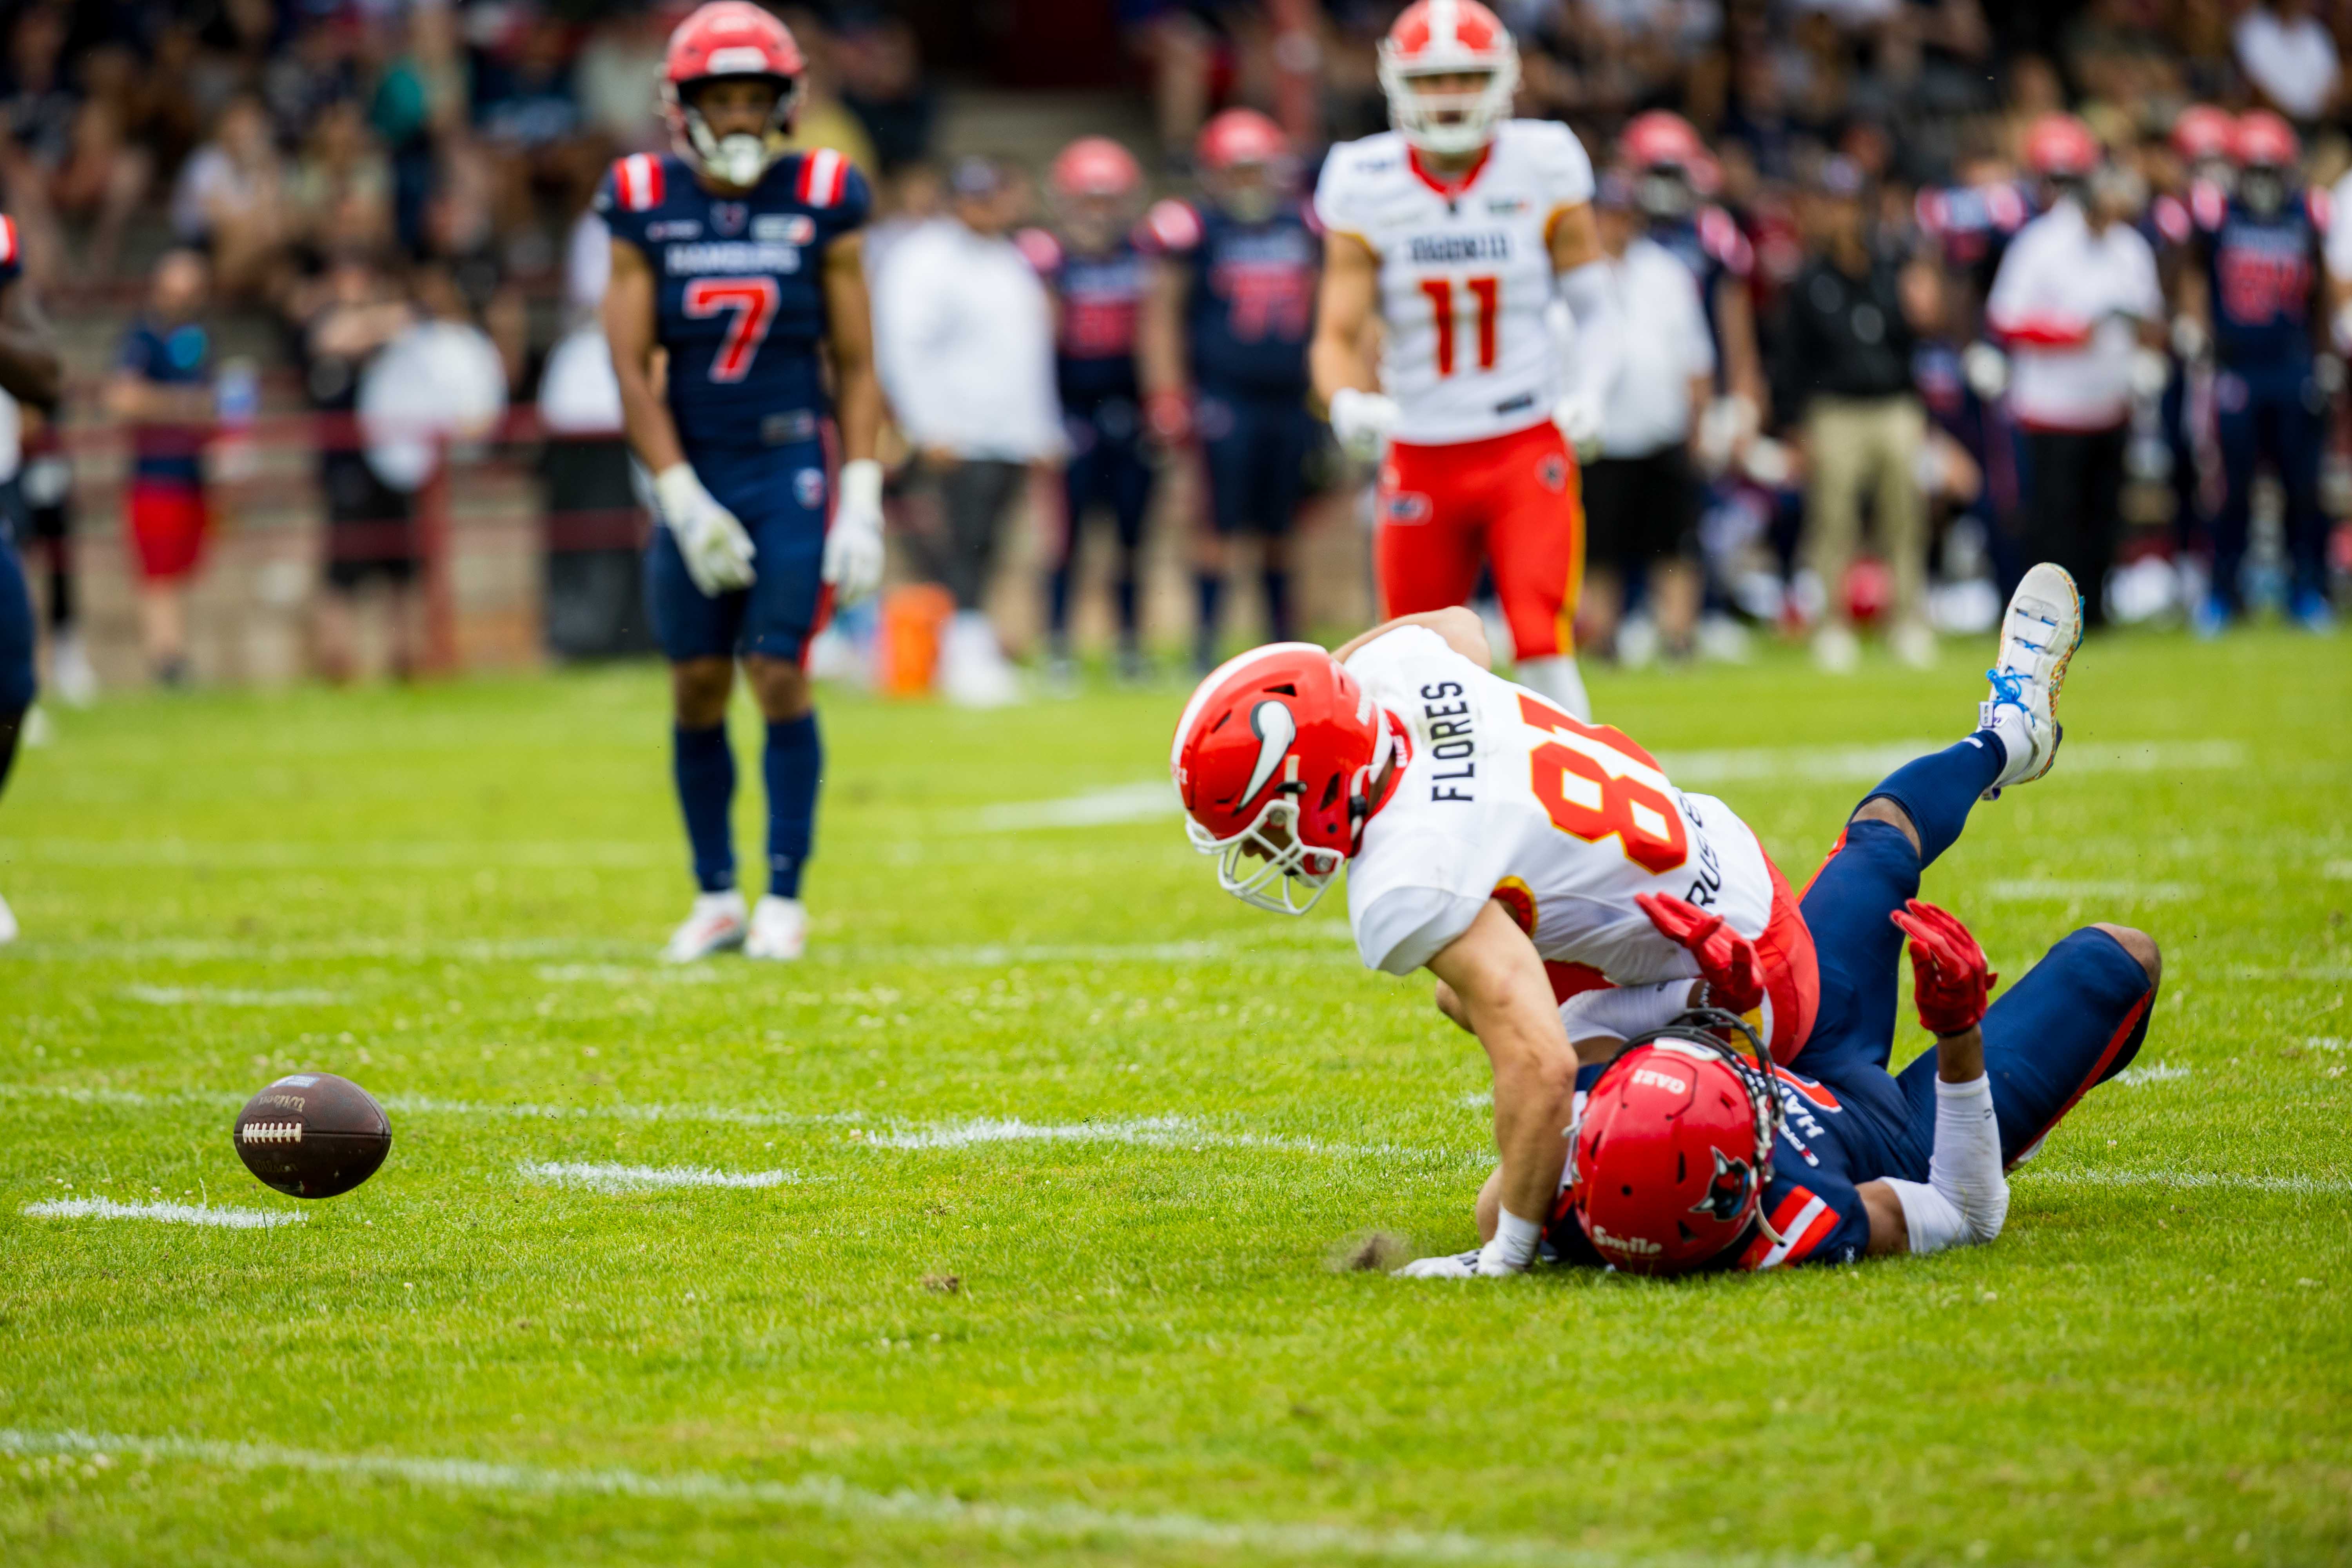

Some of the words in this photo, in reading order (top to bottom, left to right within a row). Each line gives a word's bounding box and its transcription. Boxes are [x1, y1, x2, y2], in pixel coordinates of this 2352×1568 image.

[684, 277, 779, 382] 7
[1419, 275, 1498, 377] 11
[1420, 681, 1474, 802] FLORES
[1516, 692, 1688, 876] 81
[258, 1094, 305, 1112] Wilson
[1593, 1224, 1662, 1254] Smile
